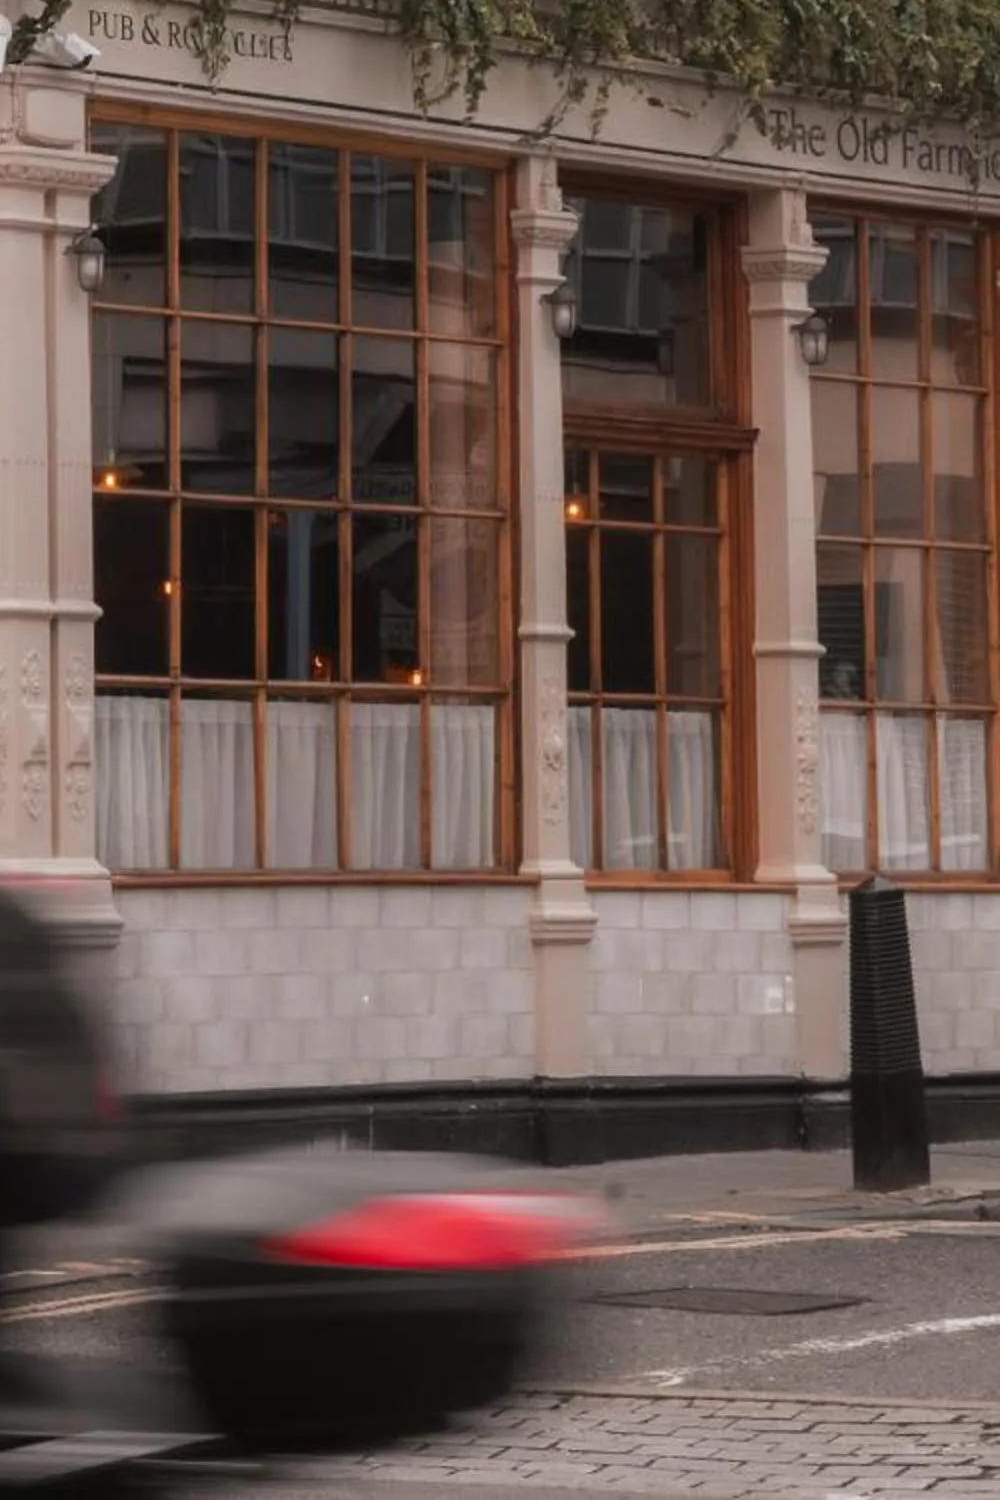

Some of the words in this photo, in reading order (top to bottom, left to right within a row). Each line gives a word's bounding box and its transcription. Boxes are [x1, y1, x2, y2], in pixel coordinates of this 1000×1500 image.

[88, 10, 134, 41] PUB
[141, 14, 161, 46] &
[769, 107, 826, 157] The
[837, 116, 889, 165] Old
